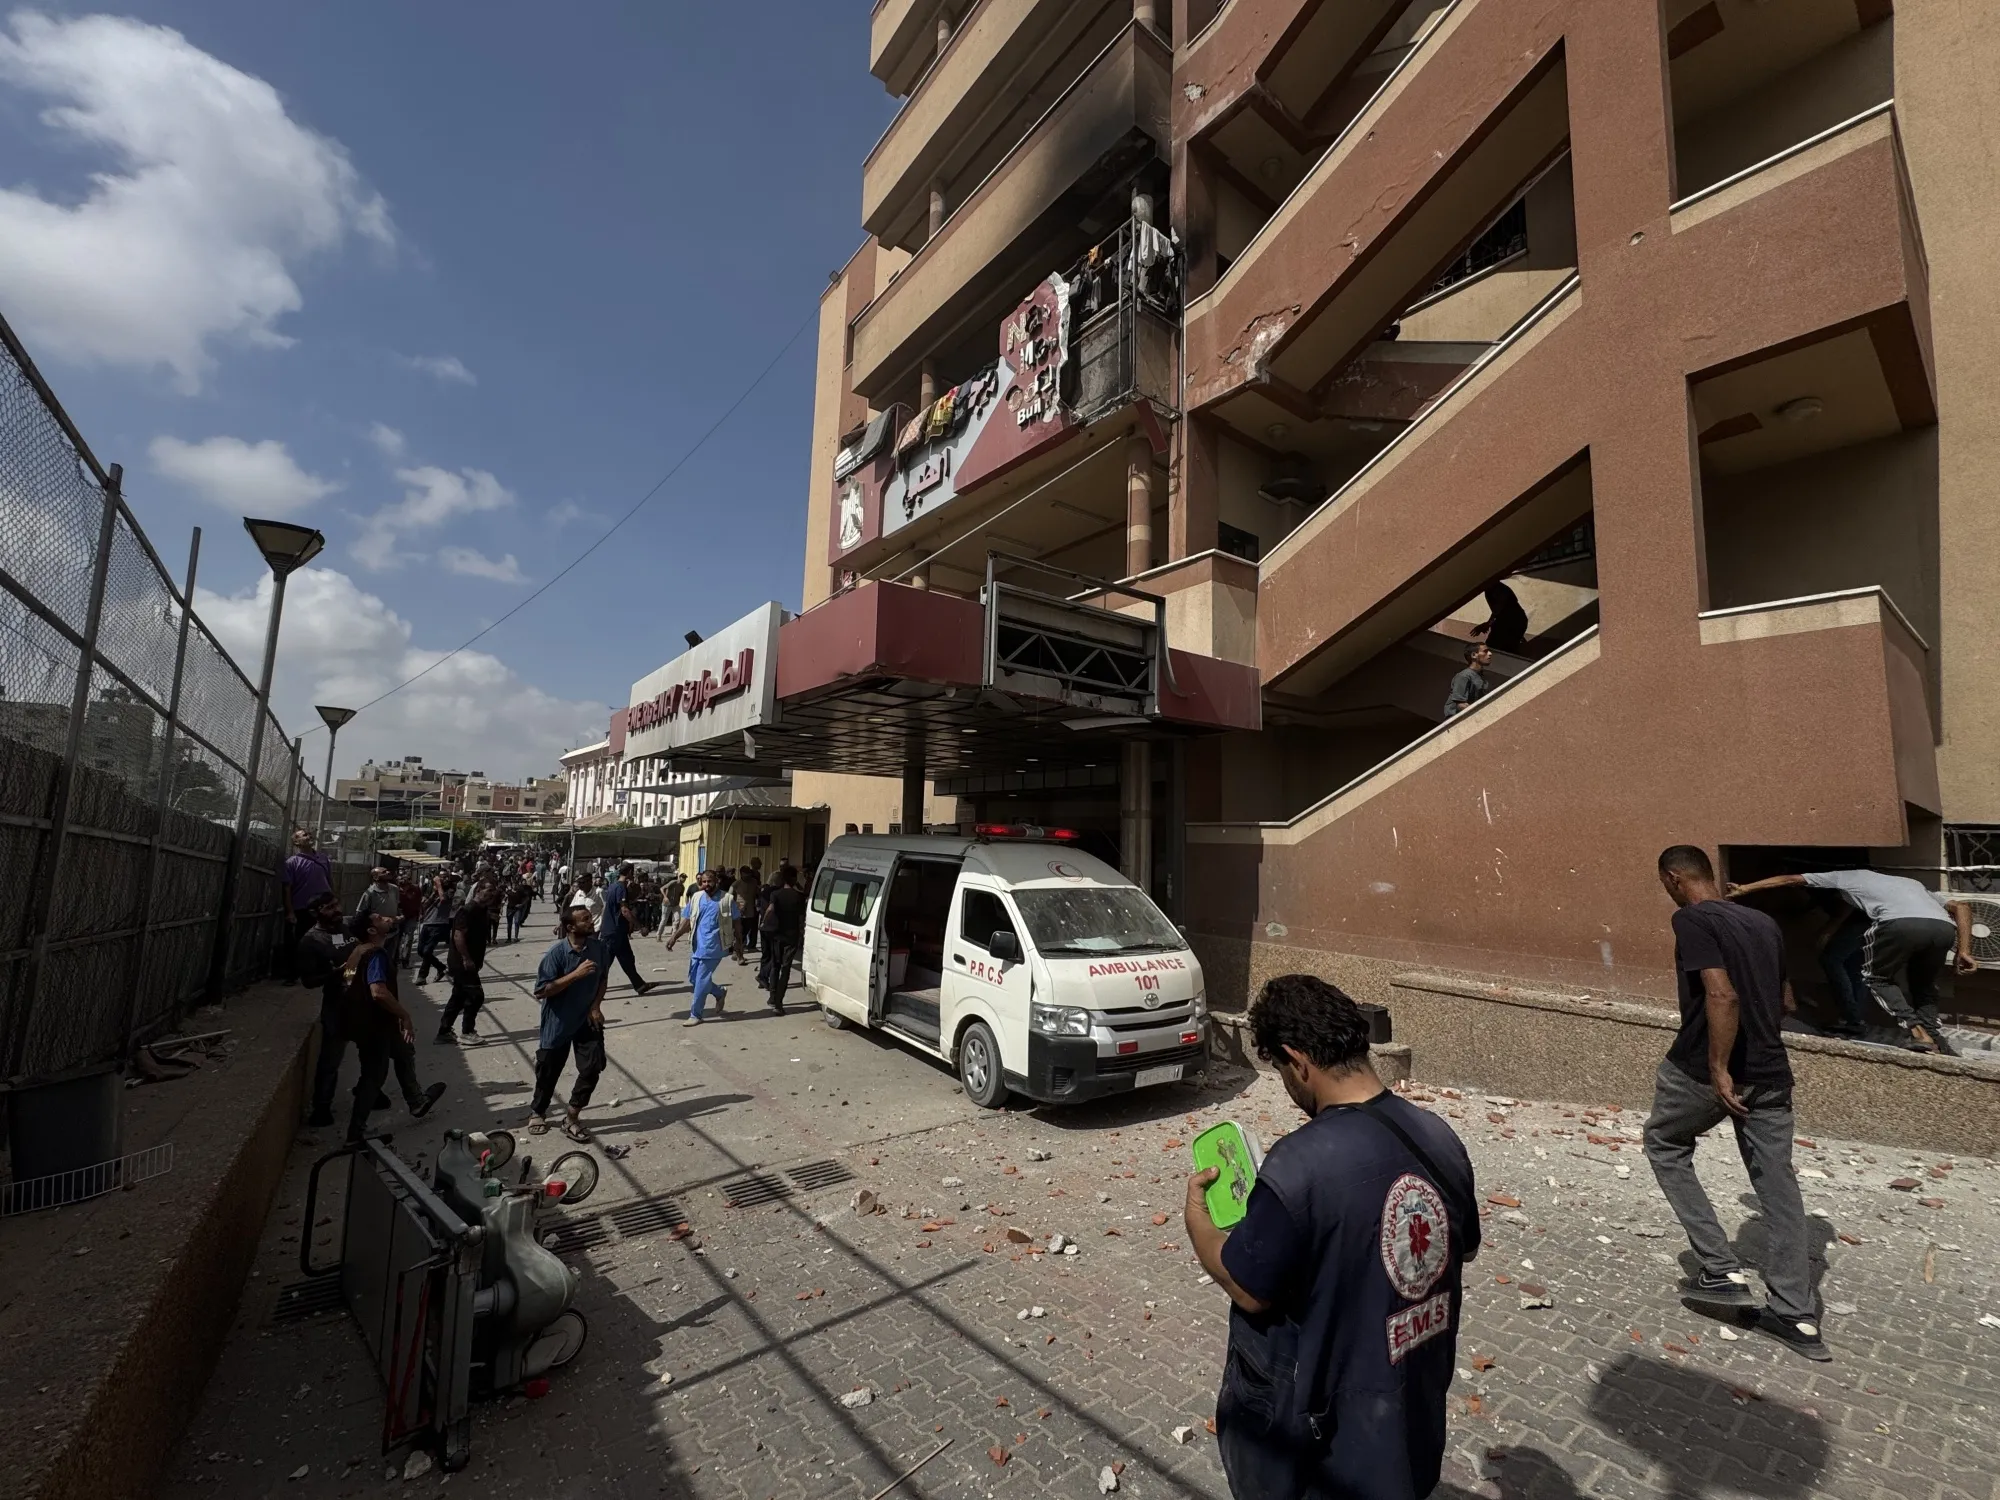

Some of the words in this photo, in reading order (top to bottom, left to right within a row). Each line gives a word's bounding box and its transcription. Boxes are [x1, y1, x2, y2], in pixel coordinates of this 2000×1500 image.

[627, 684, 683, 733] EMERGENCY
[1088, 958, 1186, 977] AMBULANCE
[1134, 975, 1160, 991] 101
